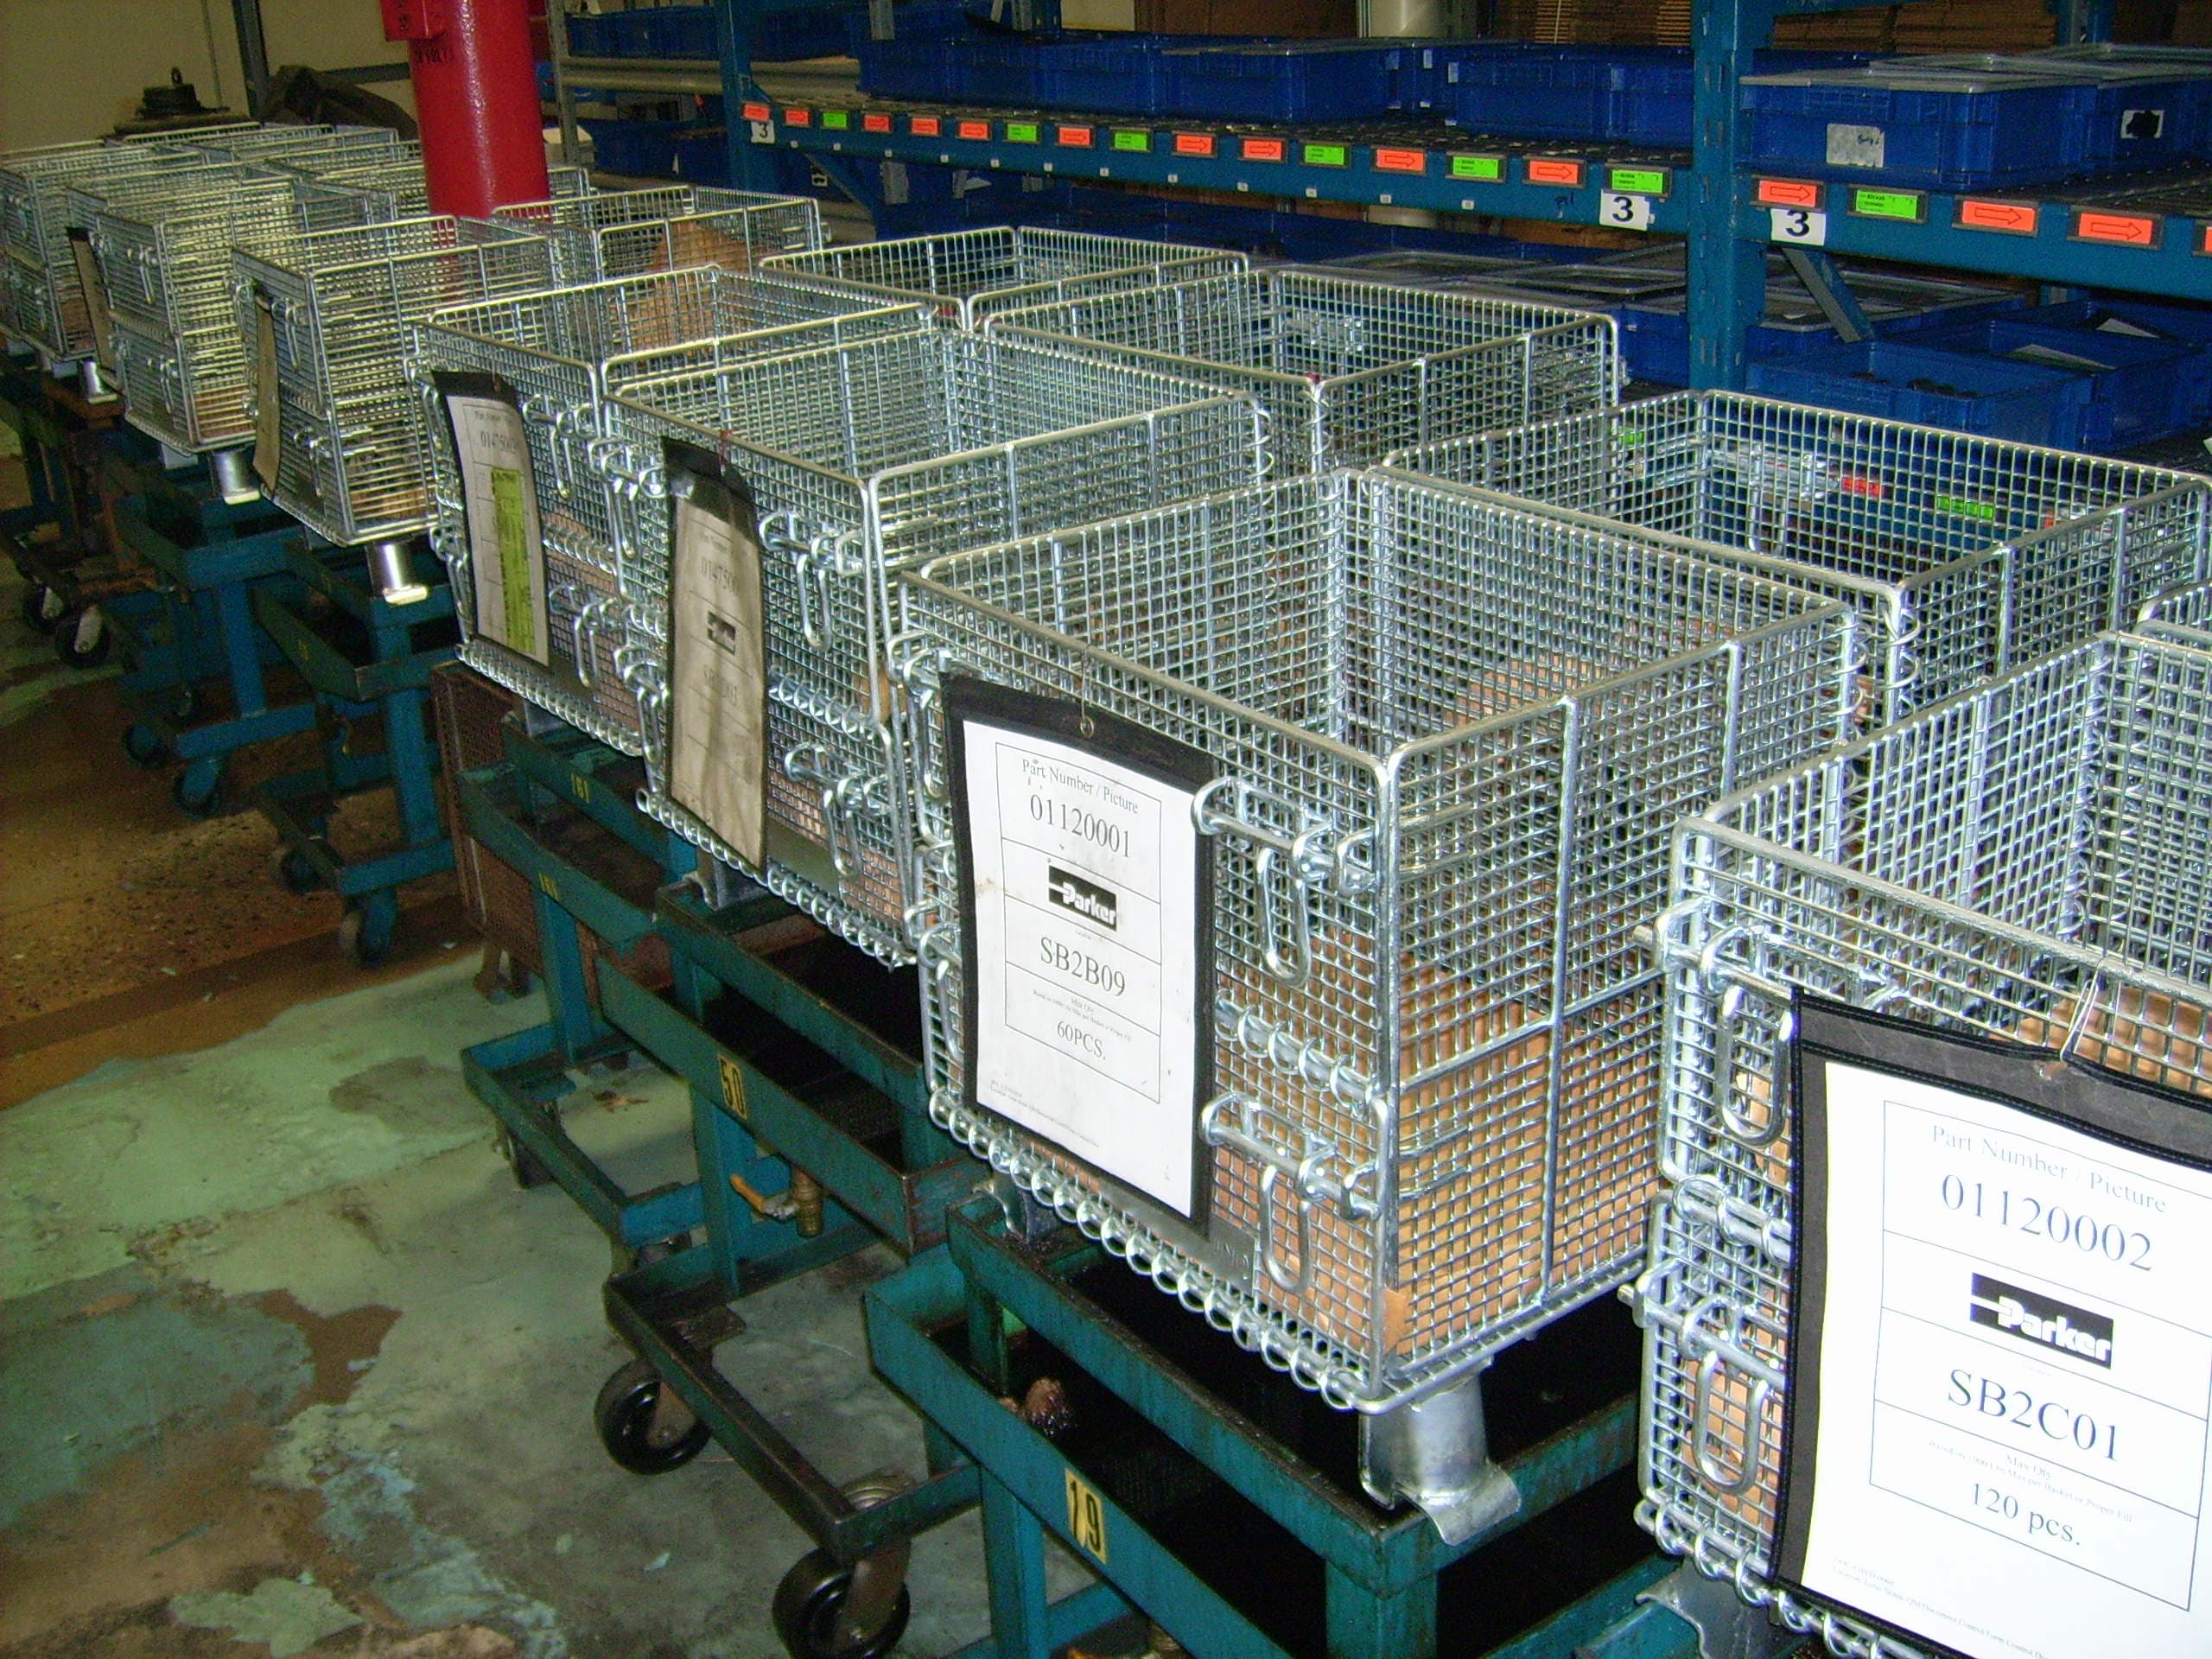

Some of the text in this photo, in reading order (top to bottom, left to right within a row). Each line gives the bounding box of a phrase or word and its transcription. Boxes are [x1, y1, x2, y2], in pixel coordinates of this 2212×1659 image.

[759, 123, 768, 138] 3
[1611, 196, 1634, 223] 3
[1785, 209, 1810, 237] 3
[1022, 759, 1046, 779] Part
[1049, 766, 1094, 795] Number
[1103, 785, 1138, 814] Picture
[1030, 794, 1130, 858] 01120001
[1062, 880, 1116, 926] Parker
[1040, 937, 1126, 997] SB2B09
[1057, 1020, 1106, 1061] 60PCS.
[720, 1057, 745, 1116] 50
[1932, 1124, 1973, 1153] Part
[1982, 1137, 2068, 1179] Number
[2089, 1171, 2167, 1213] Picture
[1942, 1174, 2152, 1272] 01120002
[1997, 1294, 2113, 1363] Parker
[1948, 1369, 2117, 1462] SB2C01
[2005, 1453, 2029, 1471] Max
[1070, 1479, 1101, 1553] 19
[1973, 1482, 2081, 1547] 120 pcs.
